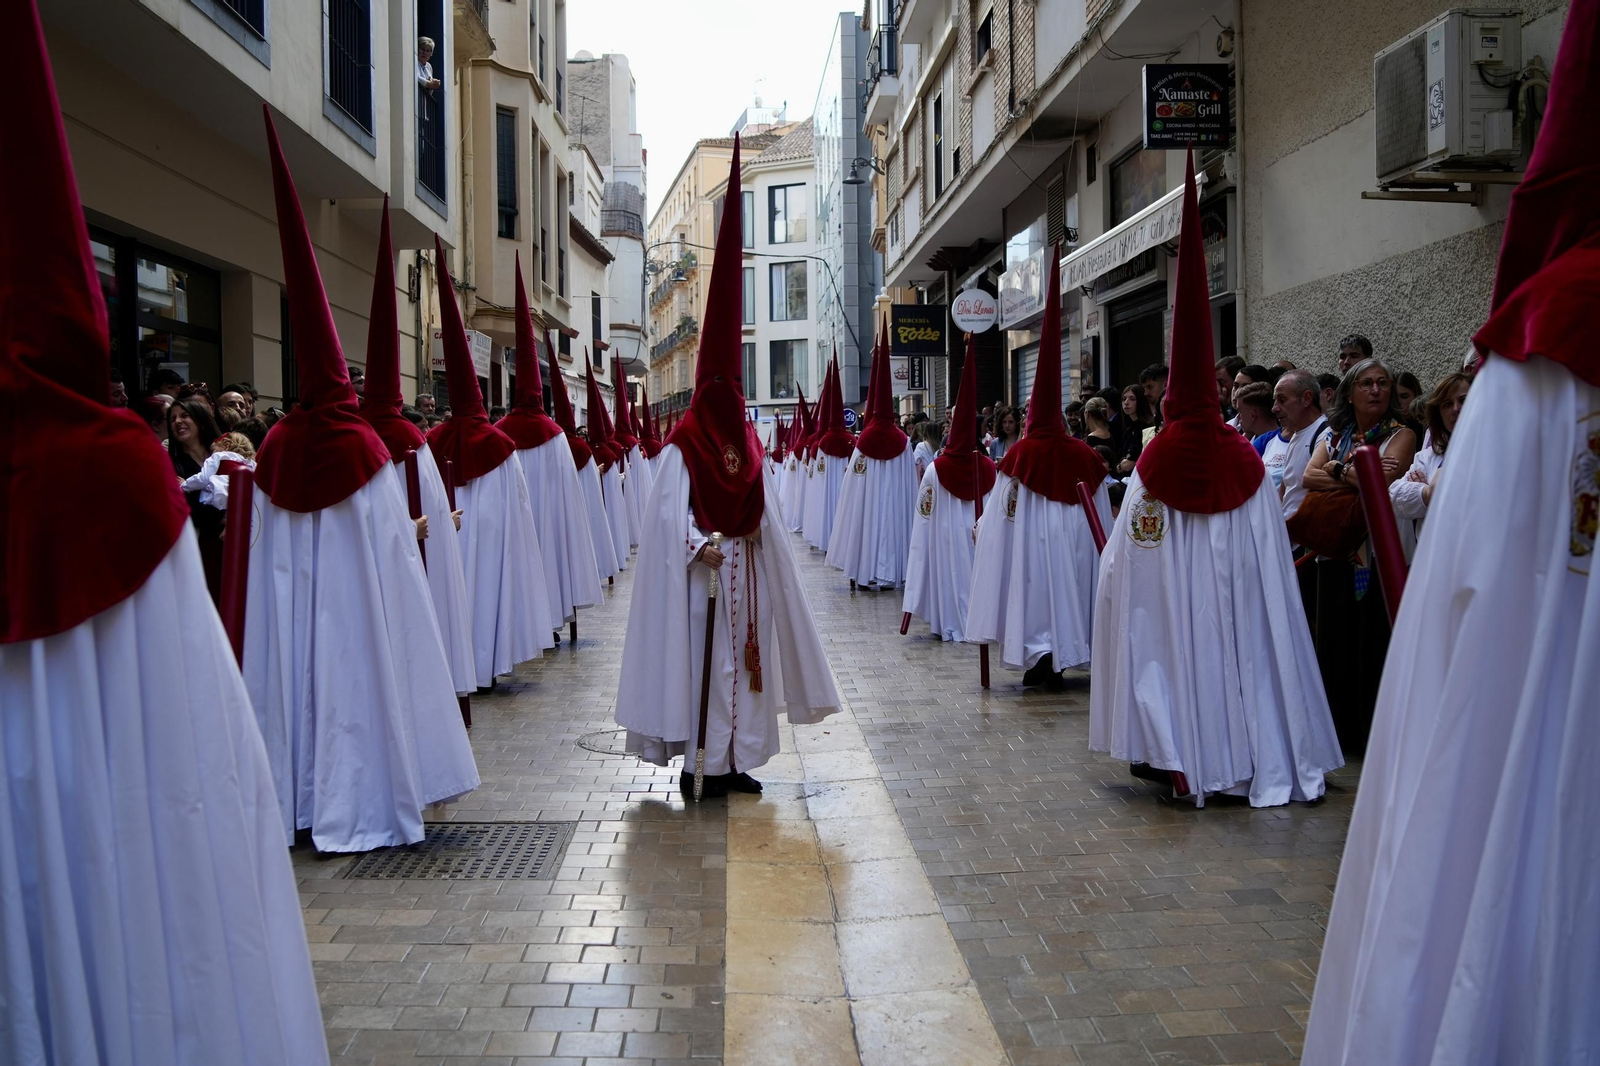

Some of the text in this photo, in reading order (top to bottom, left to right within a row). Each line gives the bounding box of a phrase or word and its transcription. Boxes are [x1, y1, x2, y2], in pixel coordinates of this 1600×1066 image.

[1152, 77, 1169, 92] Indian
[1196, 71, 1224, 92] Restaurant
[1158, 87, 1210, 101] Namaste
[1198, 104, 1221, 118] Grill
[1088, 243, 1117, 277] Restaurant
[1212, 247, 1225, 271] Grill
[957, 300, 972, 315] Dos
[974, 299, 995, 315] Lunas
[897, 326, 940, 344] Torre
